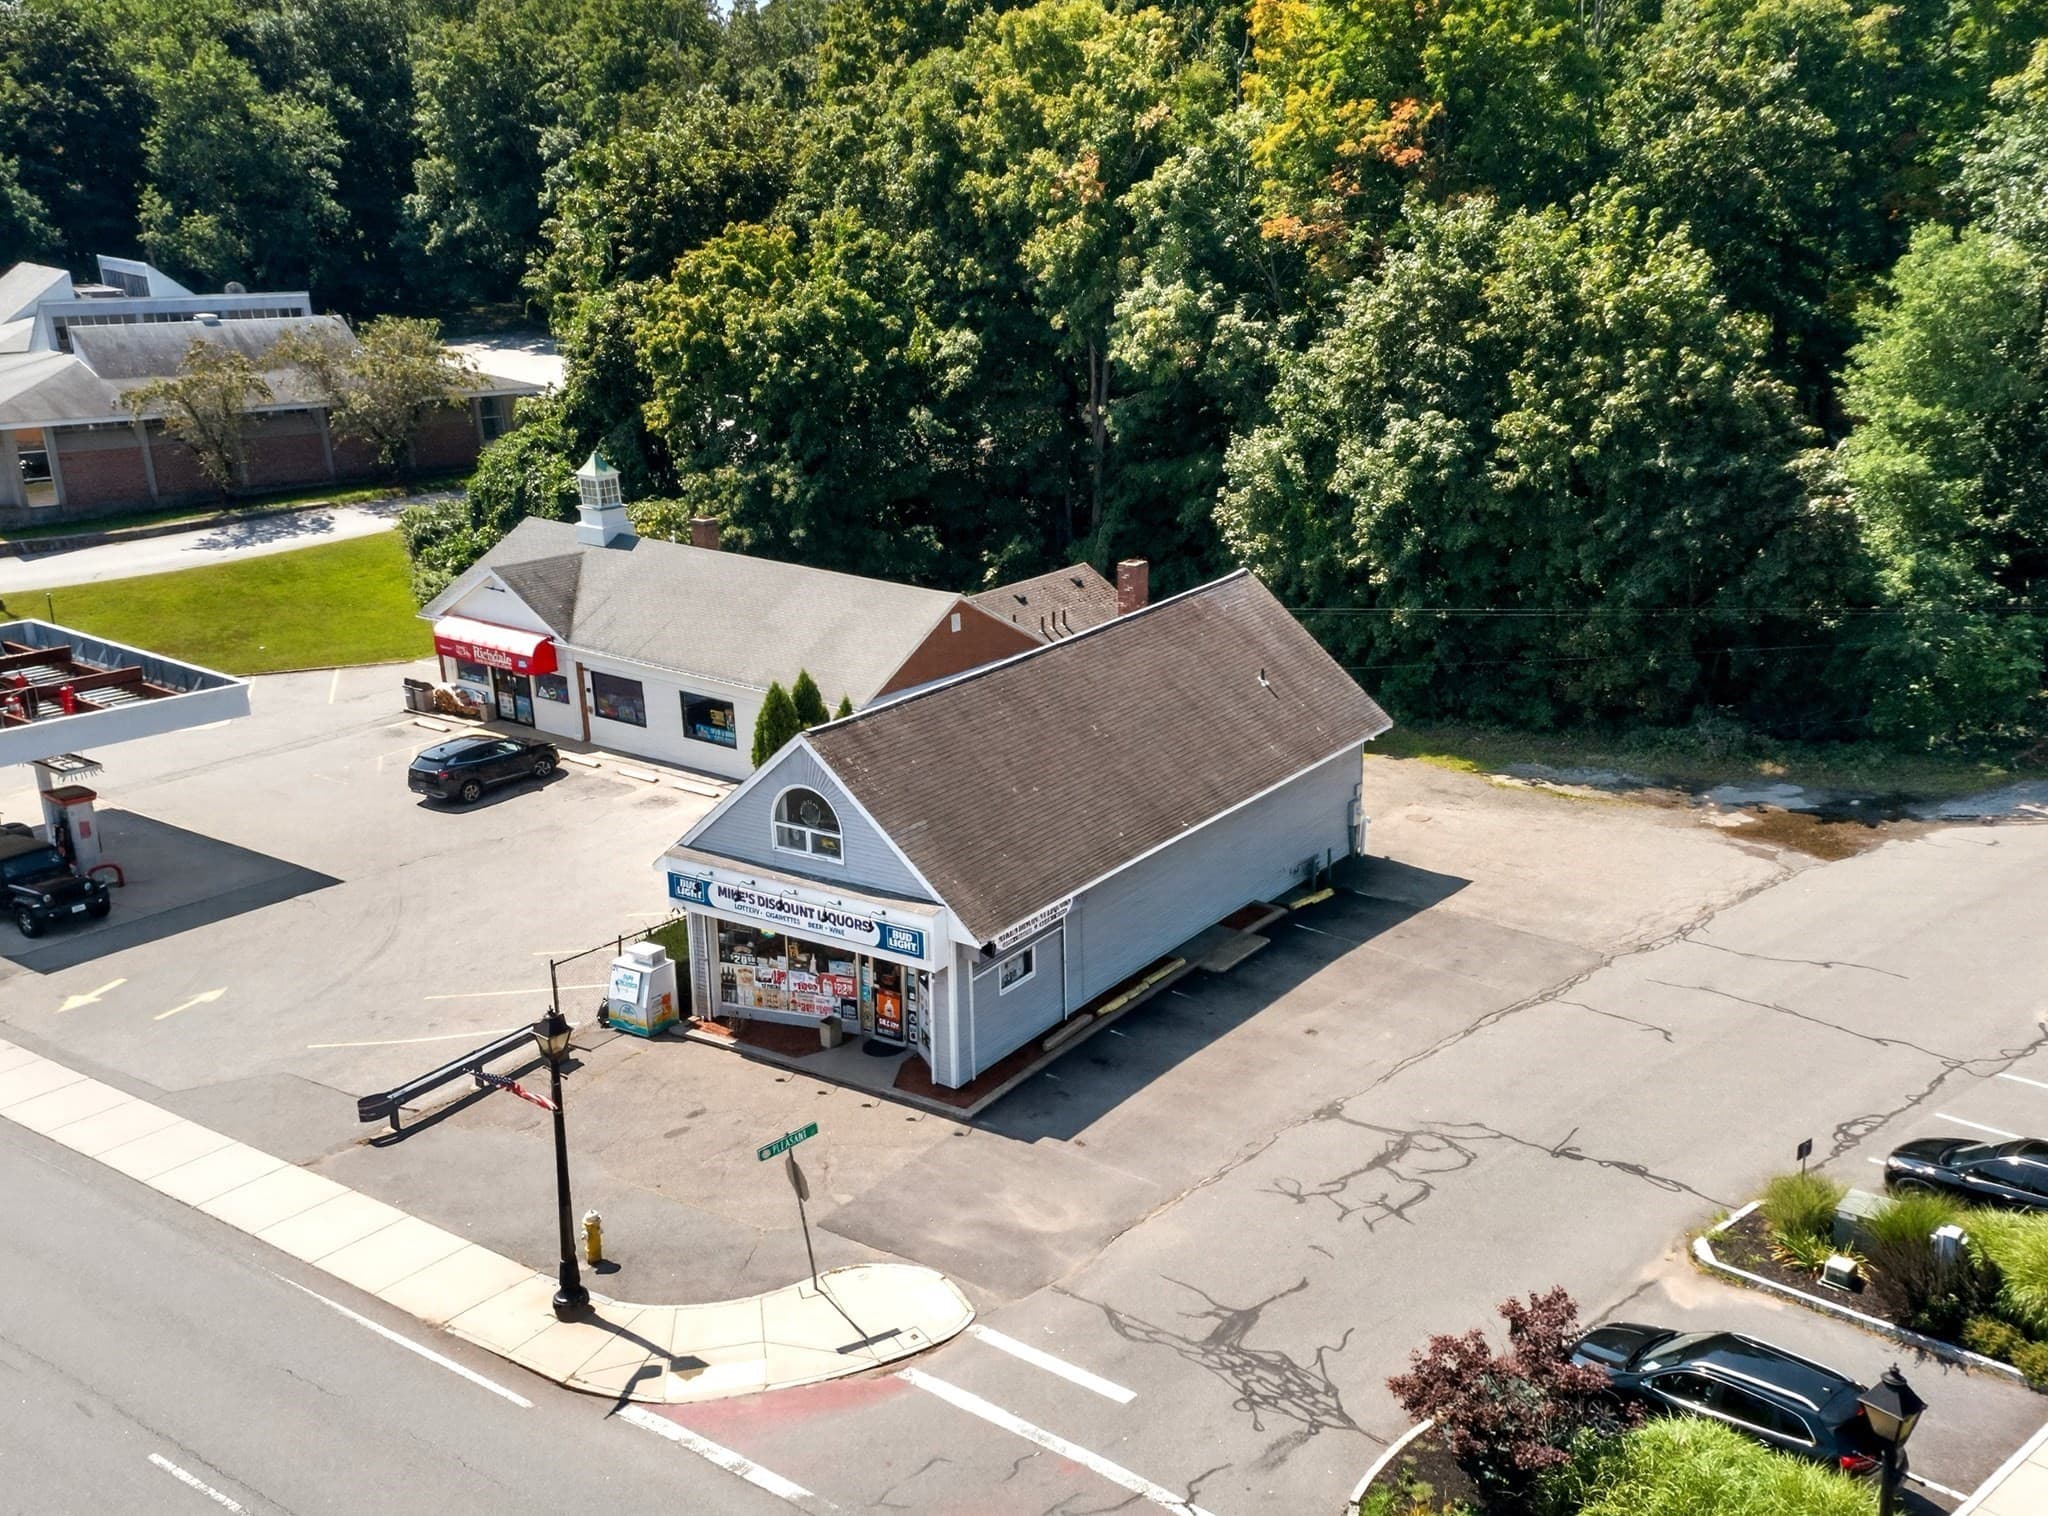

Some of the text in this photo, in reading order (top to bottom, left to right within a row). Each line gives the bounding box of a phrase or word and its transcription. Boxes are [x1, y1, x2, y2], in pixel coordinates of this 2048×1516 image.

[817, 909, 872, 932] LQUORS
[891, 929, 913, 941] BUD
[889, 938, 918, 952] LIGHT
[772, 1130, 807, 1154] PLEASANT
